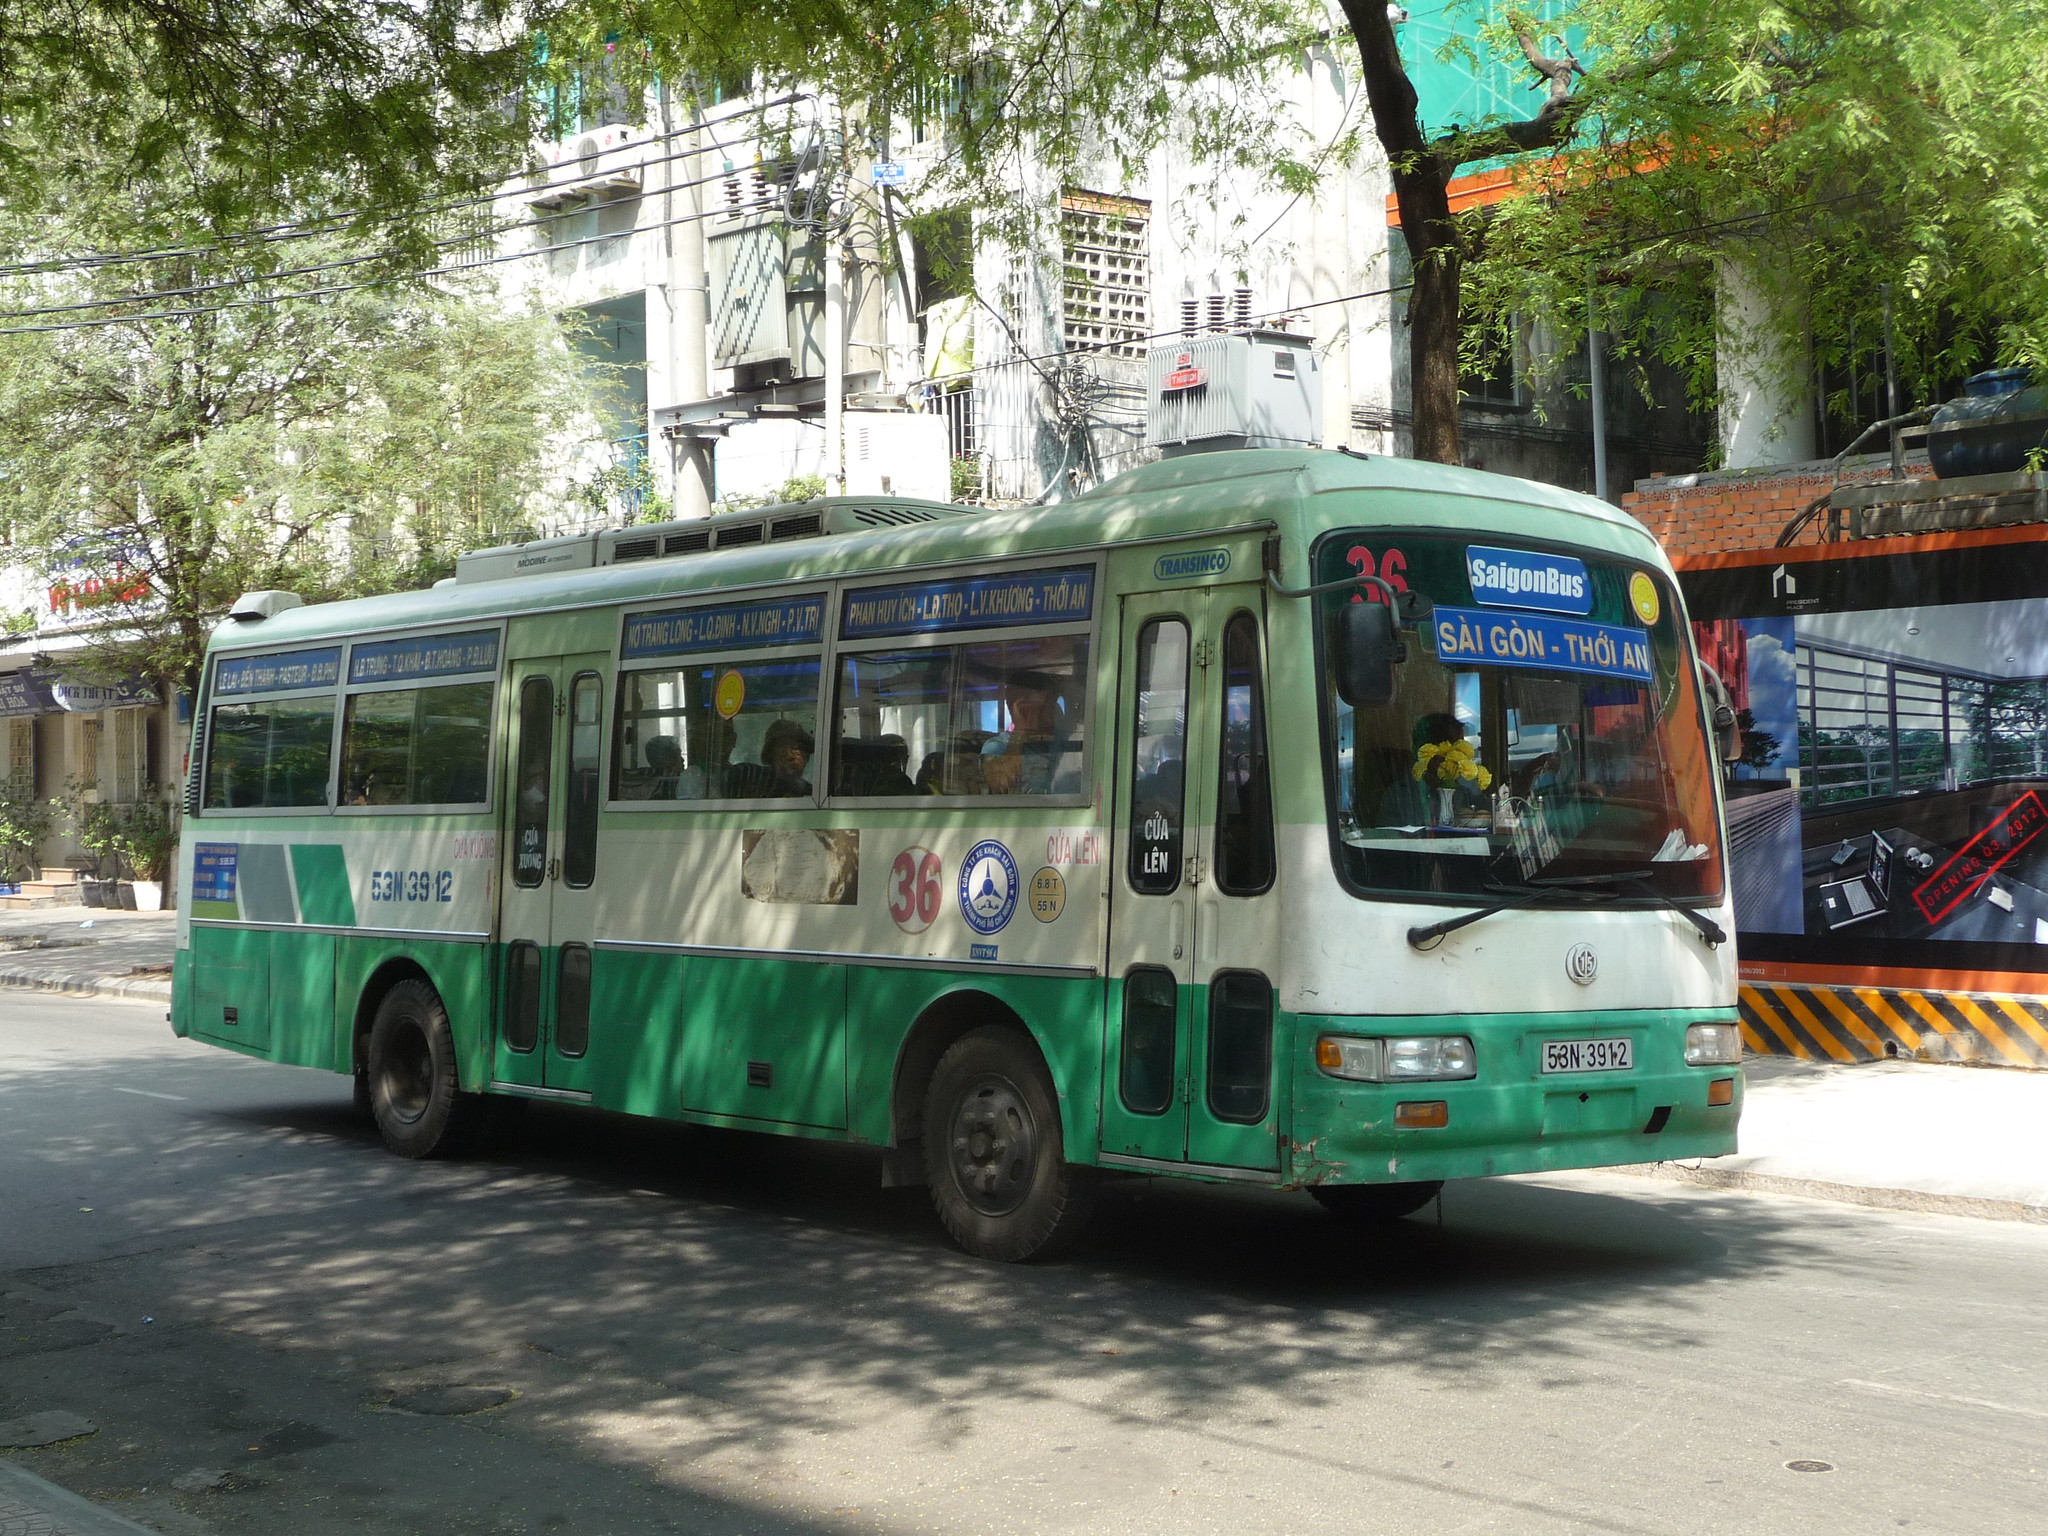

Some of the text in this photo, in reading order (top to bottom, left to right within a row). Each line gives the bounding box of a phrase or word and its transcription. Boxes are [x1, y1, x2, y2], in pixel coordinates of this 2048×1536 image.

[517, 555, 548, 569] MODINE
[1160, 552, 1226, 576] TRANSINCO
[1346, 545, 1409, 607] 36
[1471, 557, 1584, 599] SaigonBus
[848, 600, 875, 626] PHAN
[876, 598, 897, 624] HUY
[898, 590, 916, 622] ÍCH
[922, 591, 963, 624] L.Đ.THỌ
[969, 582, 1034, 616] L.V.KHƯƠNG
[1042, 577, 1070, 611] THỚI
[1069, 583, 1087, 610] AN
[640, 621, 668, 647] TRANG
[669, 618, 693, 644] LONG
[741, 608, 781, 637] N.V.NGHI
[1439, 615, 1484, 655] SÀI
[1489, 619, 1546, 659] GÒN
[1563, 630, 1618, 667] THỚI
[1622, 643, 1650, 673] AN
[1144, 811, 1169, 840] CỬA
[1047, 829, 1099, 865] CỬA LÊN
[1144, 846, 1168, 873] LÊN
[1926, 856, 1981, 907] OPENING
[2007, 807, 2039, 838] 2012
[890, 852, 942, 924] 36
[1037, 878, 1058, 889] 6.8 T
[1037, 900, 1056, 912] 55 N
